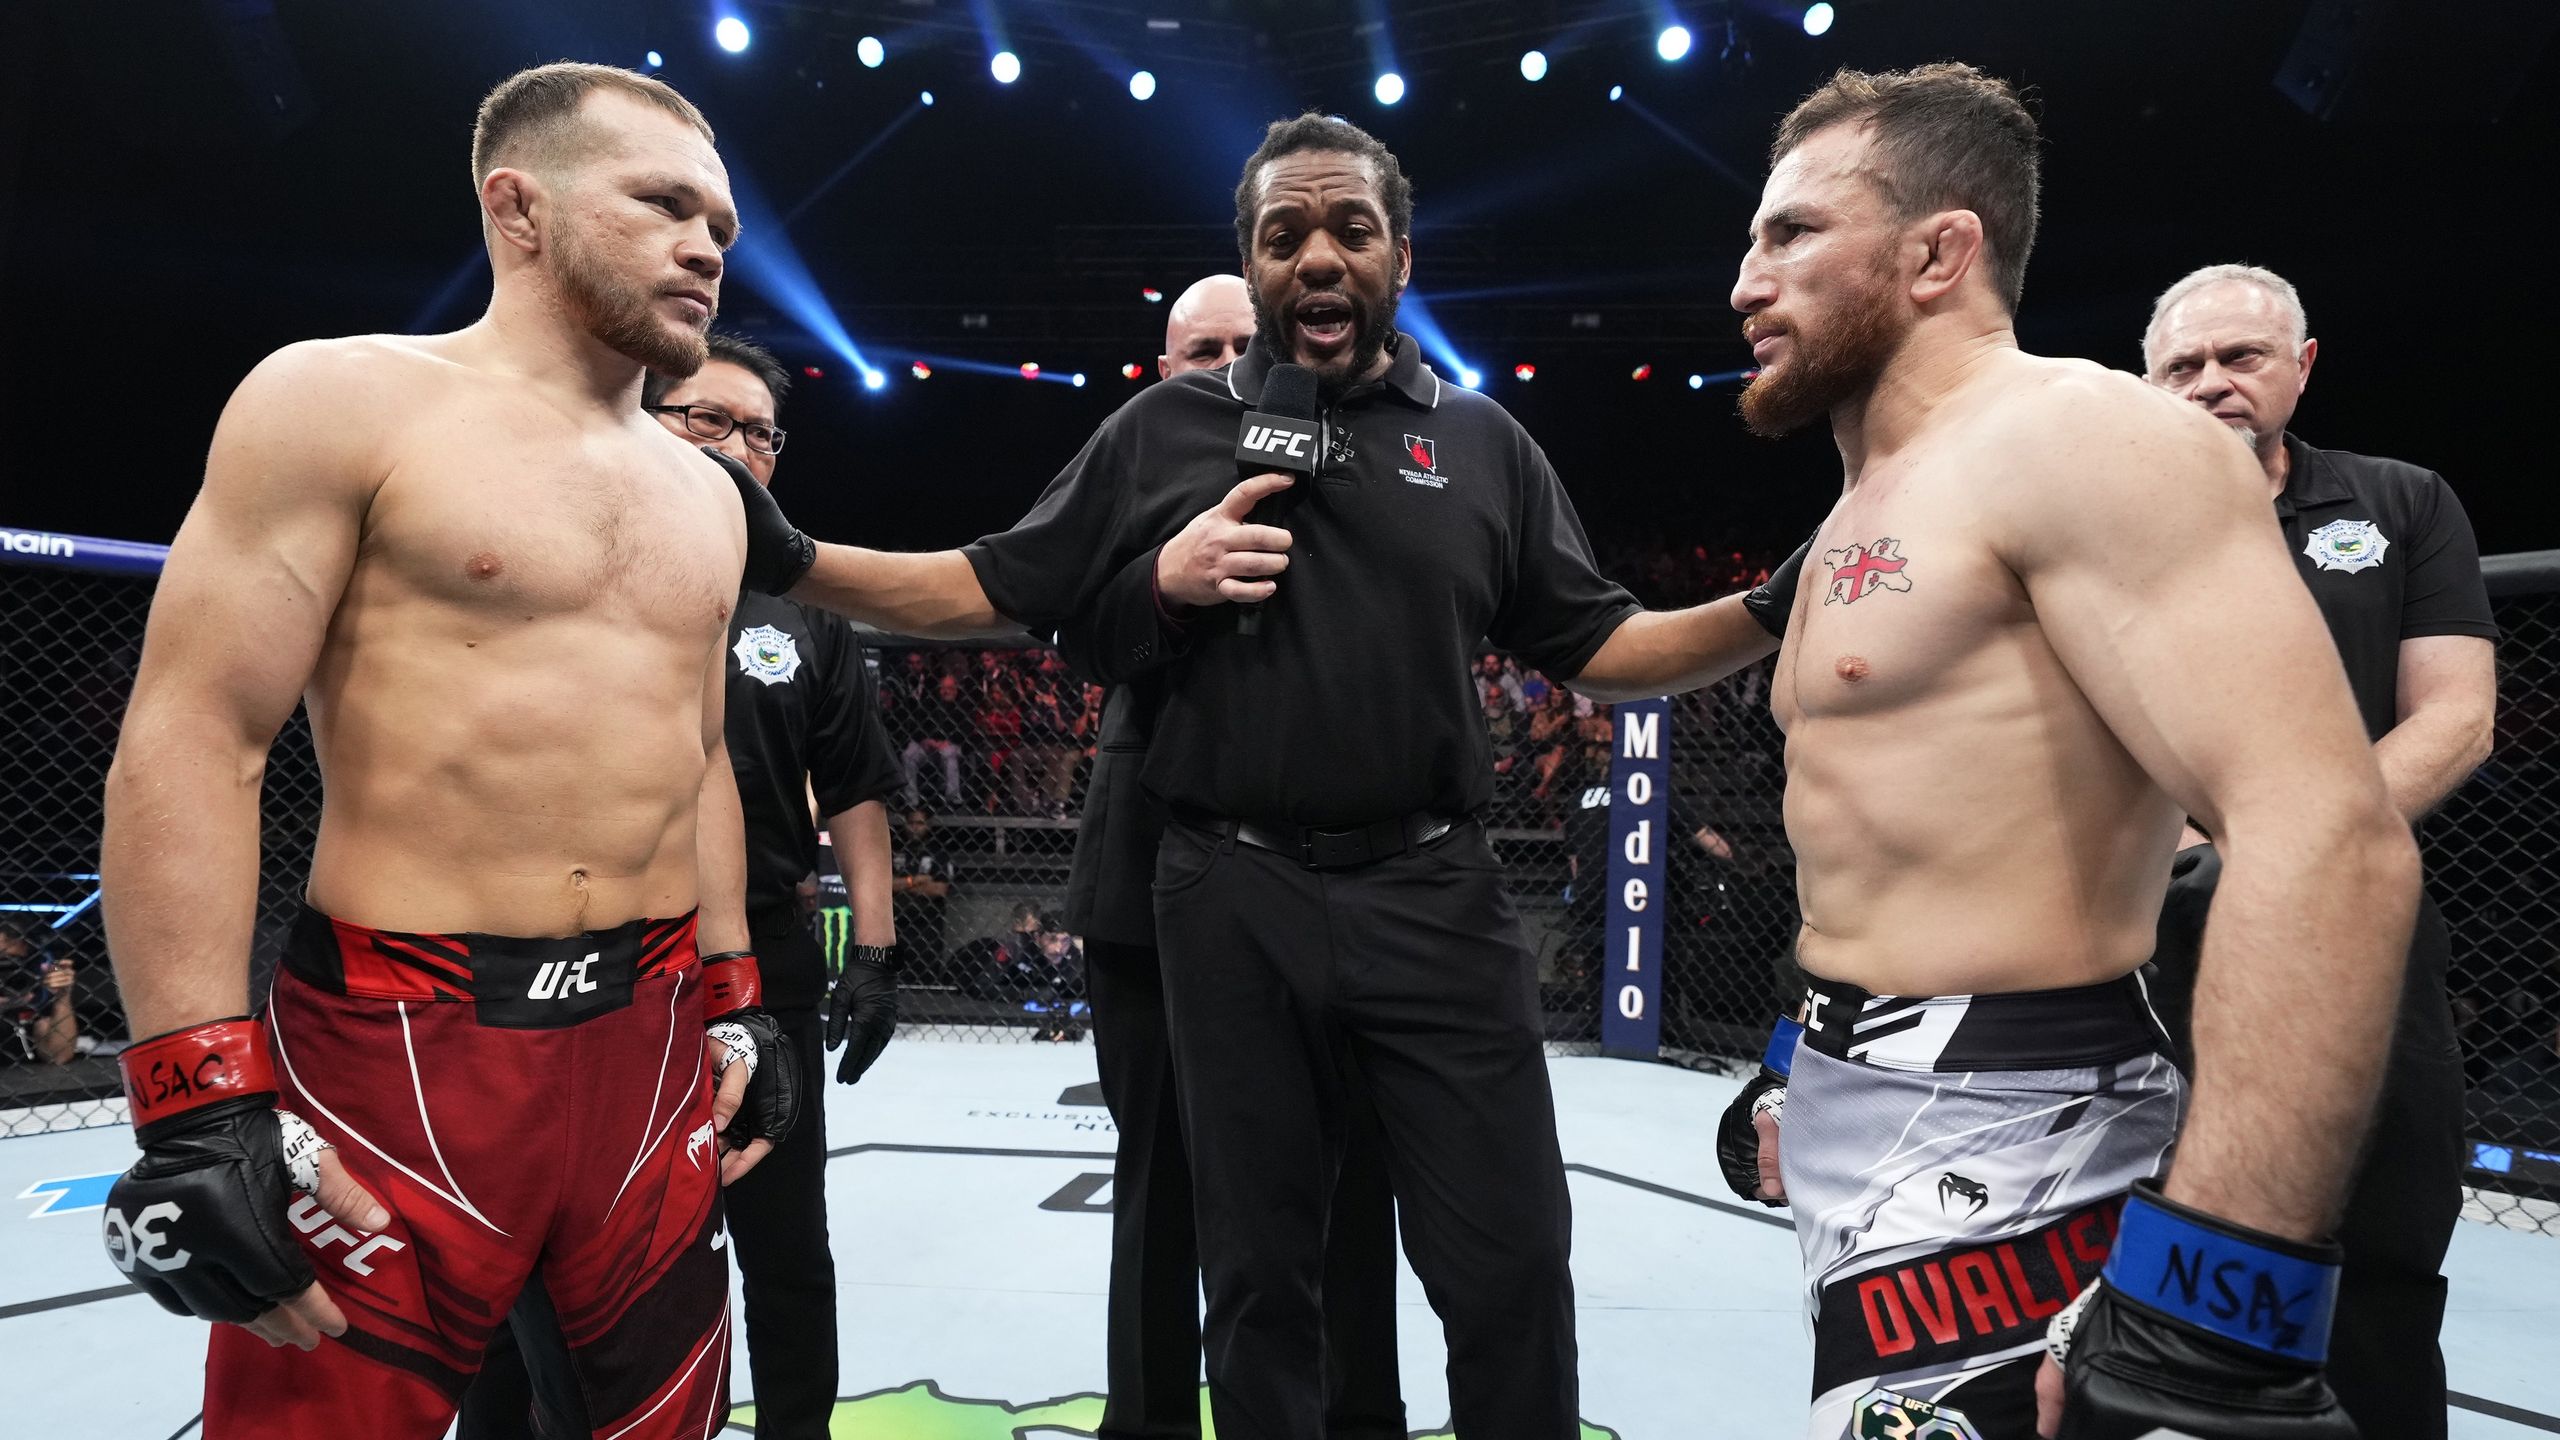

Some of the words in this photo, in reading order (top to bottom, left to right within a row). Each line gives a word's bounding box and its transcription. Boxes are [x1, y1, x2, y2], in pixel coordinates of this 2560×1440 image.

[1242, 425, 1313, 458] UFC
[1618, 711, 1660, 1020] Modelo
[527, 951, 600, 1000] UFC
[130, 1053, 226, 1110] NSAC
[285, 1129, 314, 1159] UFC
[1904, 1397, 1933, 1415] UFC
